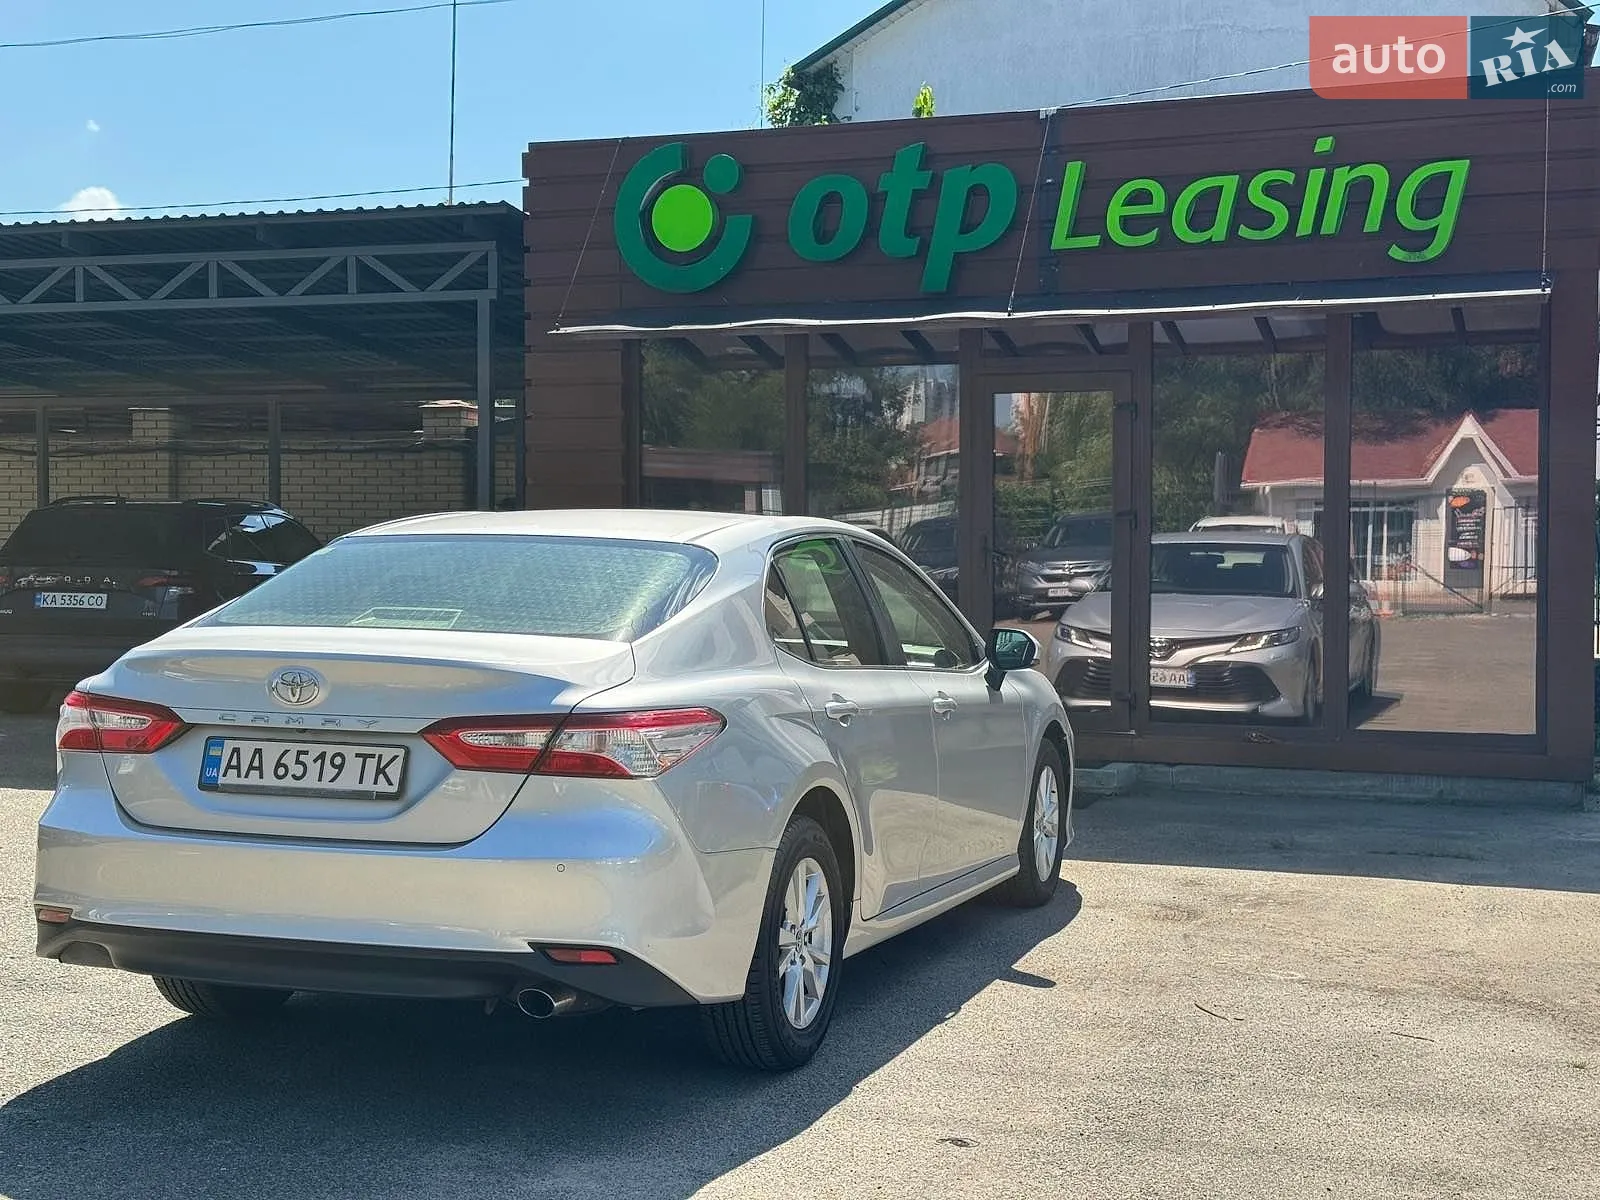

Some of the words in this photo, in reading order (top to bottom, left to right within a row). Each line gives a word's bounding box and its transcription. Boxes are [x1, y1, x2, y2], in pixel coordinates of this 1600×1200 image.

[788, 141, 1018, 293] otp
[1050, 136, 1471, 263] Leasing
[42, 593, 57, 606] KA
[60, 594, 84, 607] 5356
[87, 595, 104, 607] CO
[218, 712, 379, 728] CAMRY
[206, 767, 218, 778] UA
[221, 746, 264, 780] AA
[273, 748, 346, 783] 6519
[354, 752, 399, 786] TK
